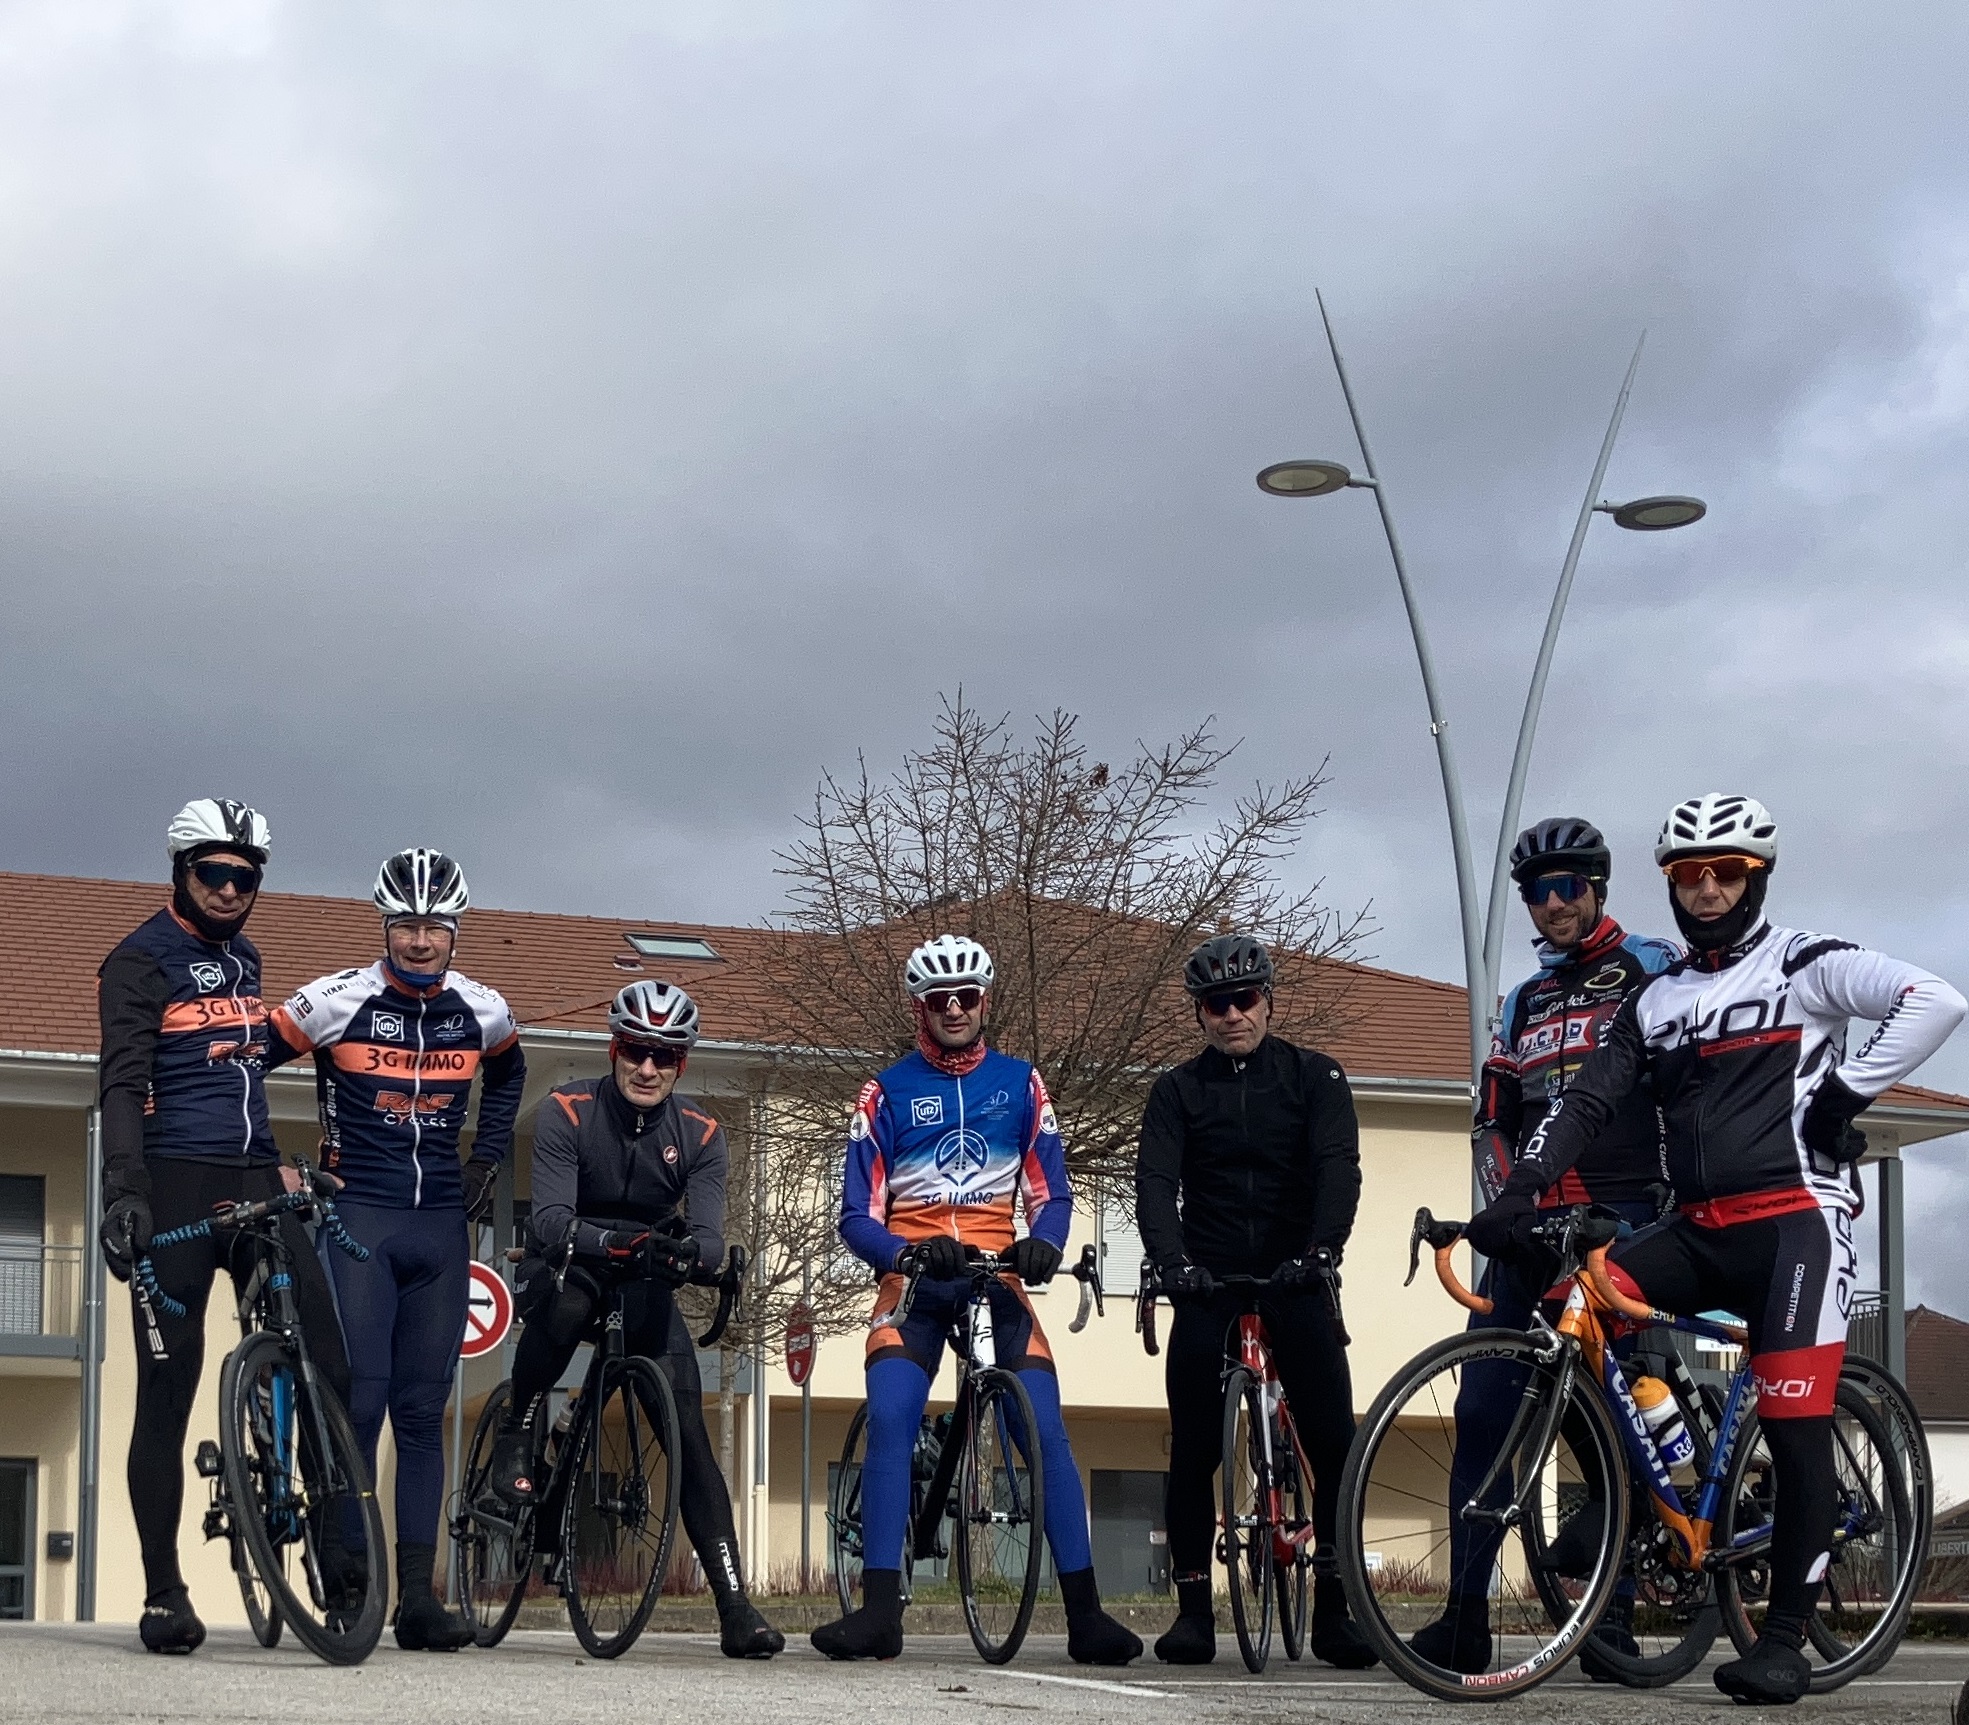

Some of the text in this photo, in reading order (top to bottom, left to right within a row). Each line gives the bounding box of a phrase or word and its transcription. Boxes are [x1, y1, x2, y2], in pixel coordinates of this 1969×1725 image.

[194, 1000, 226, 1026] 3G
[364, 1047, 466, 1072] 3G IMMO
[1784, 1263, 1806, 1333] COMPETITION
[1612, 1369, 1671, 1488] CASATI
[1875, 1384, 1923, 1481] CAMPAGNOLO
[1533, 1623, 1580, 1670] EURUS
[1464, 1664, 1530, 1687] CARBON
